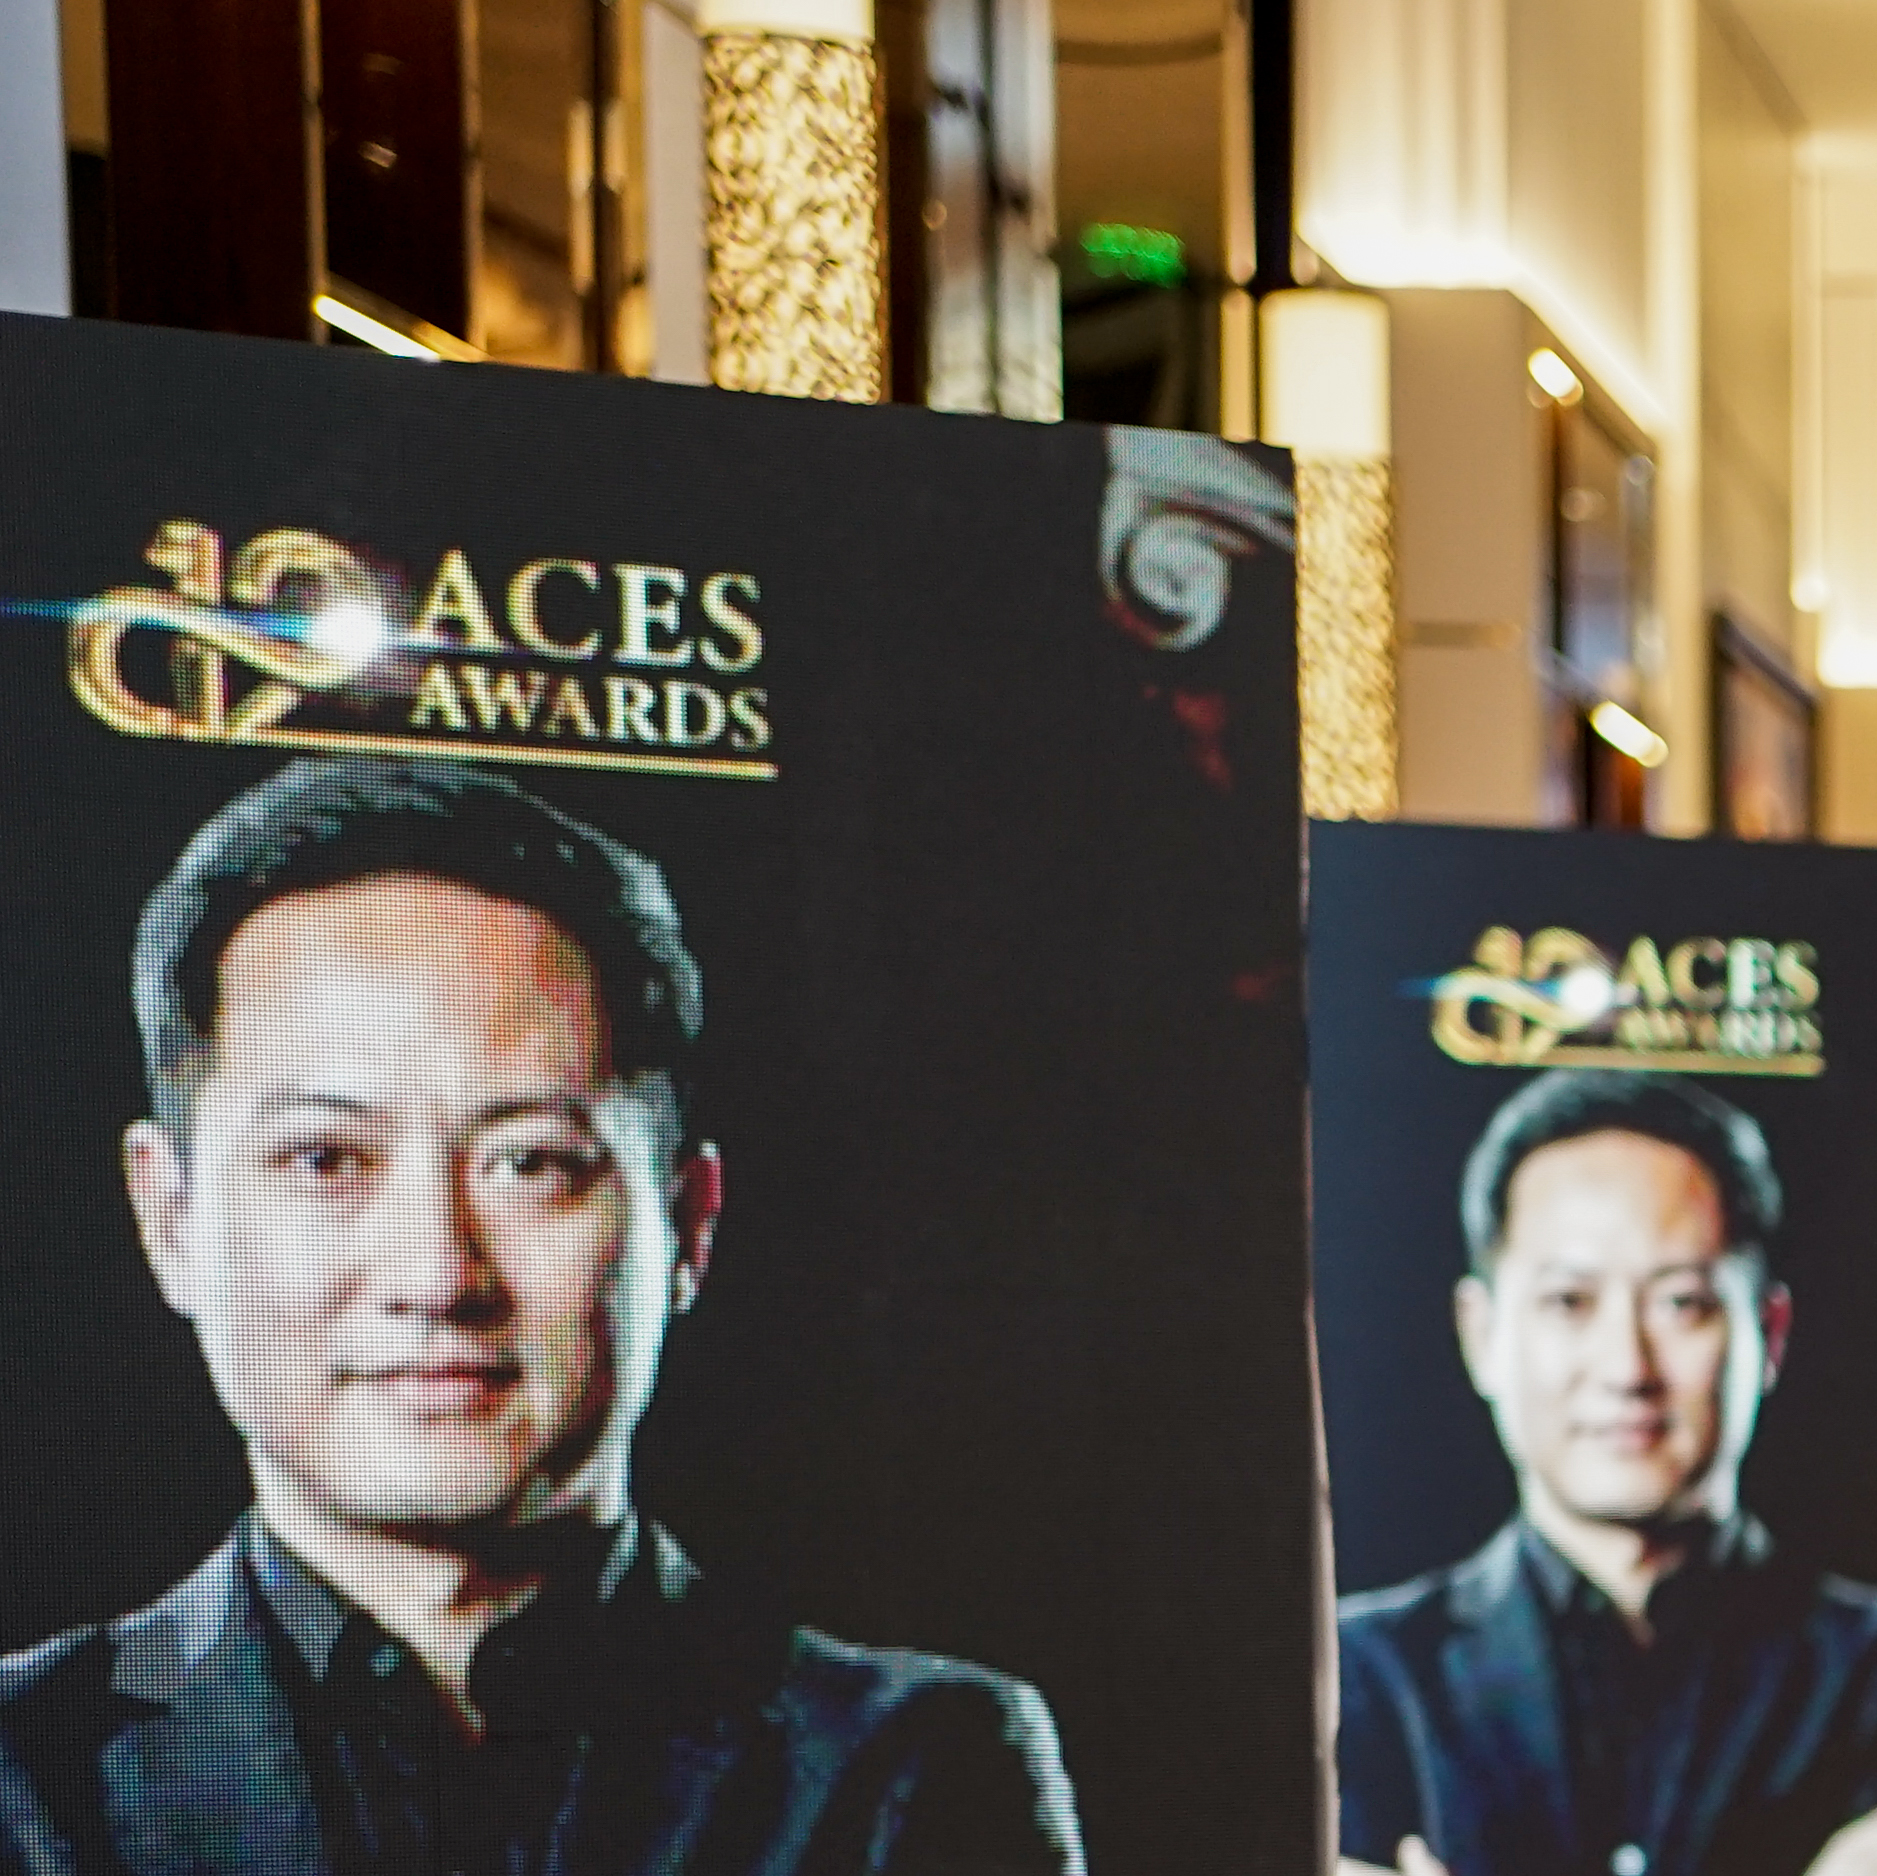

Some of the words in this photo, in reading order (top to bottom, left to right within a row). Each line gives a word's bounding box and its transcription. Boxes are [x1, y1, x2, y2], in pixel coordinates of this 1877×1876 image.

[410, 546, 765, 673] ACES
[408, 661, 774, 752] AWARDS
[1616, 935, 1821, 1011] ACES
